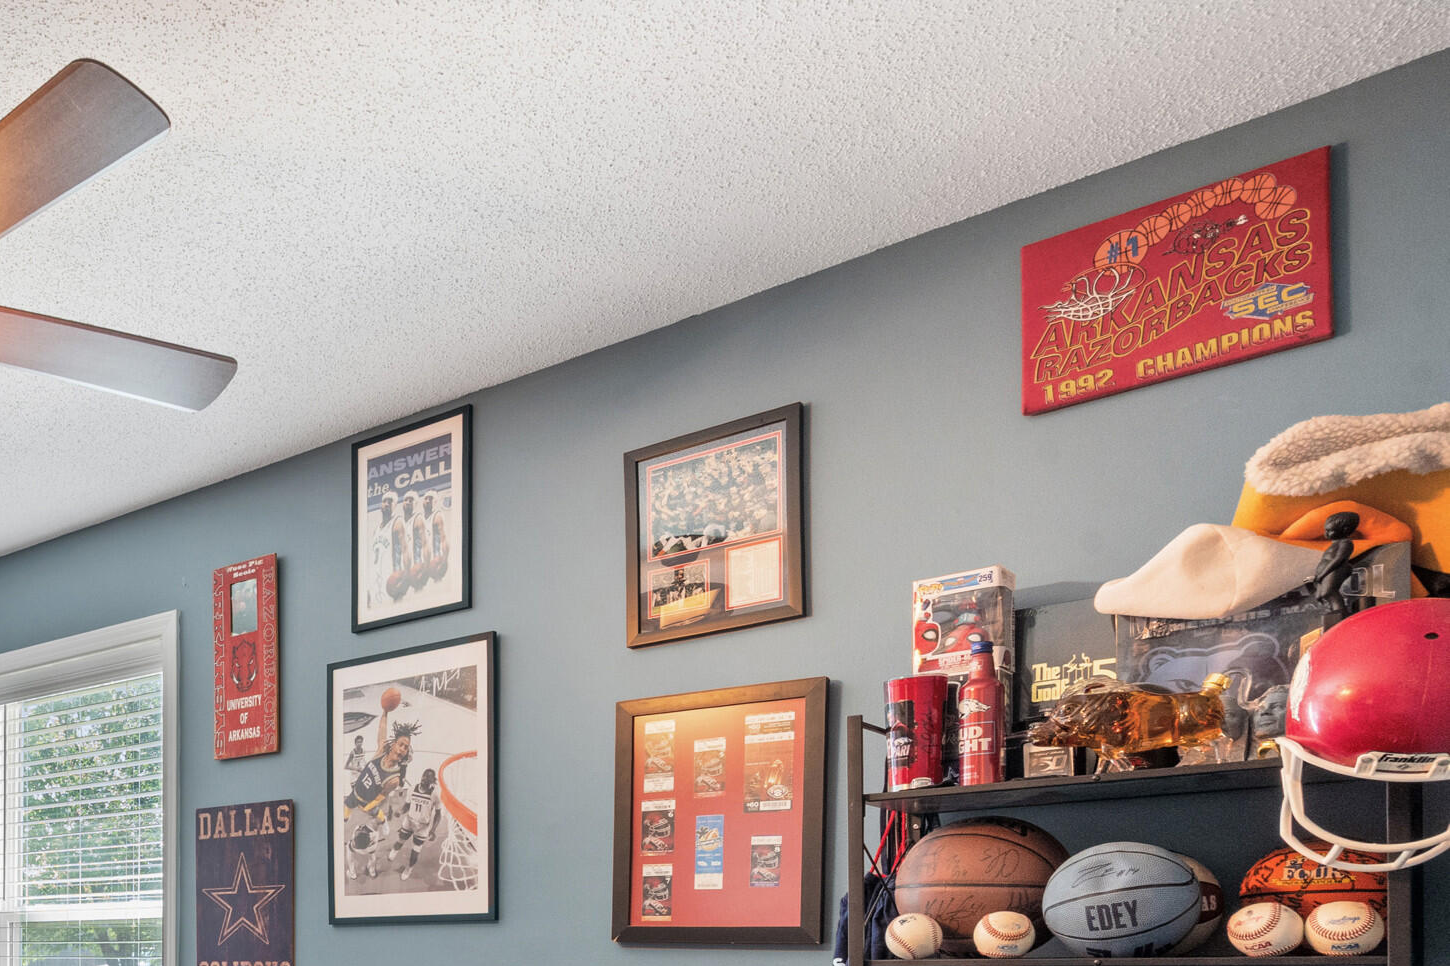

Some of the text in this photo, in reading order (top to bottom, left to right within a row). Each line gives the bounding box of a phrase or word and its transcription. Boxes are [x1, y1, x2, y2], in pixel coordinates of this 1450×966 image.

[1107, 236, 1138, 264] #1
[1030, 208, 1311, 358] ARKANSAS
[1232, 282, 1306, 318] SEC
[1034, 242, 1312, 383] RAZORBACKS
[1042, 310, 1316, 405] 1992 CHAMPIONS
[367, 442, 452, 481] ANSWER
[367, 460, 452, 498] the CALL
[262, 567, 276, 748] RAZORBACKS
[1032, 662, 1061, 682] The
[226, 695, 262, 712] UNIVERSITY
[239, 712, 248, 725] OF
[228, 726, 261, 742] ARKANSAS
[959, 738, 992, 754] GHT
[198, 804, 290, 841] DALLAS
[1085, 899, 1138, 931] EDEY
